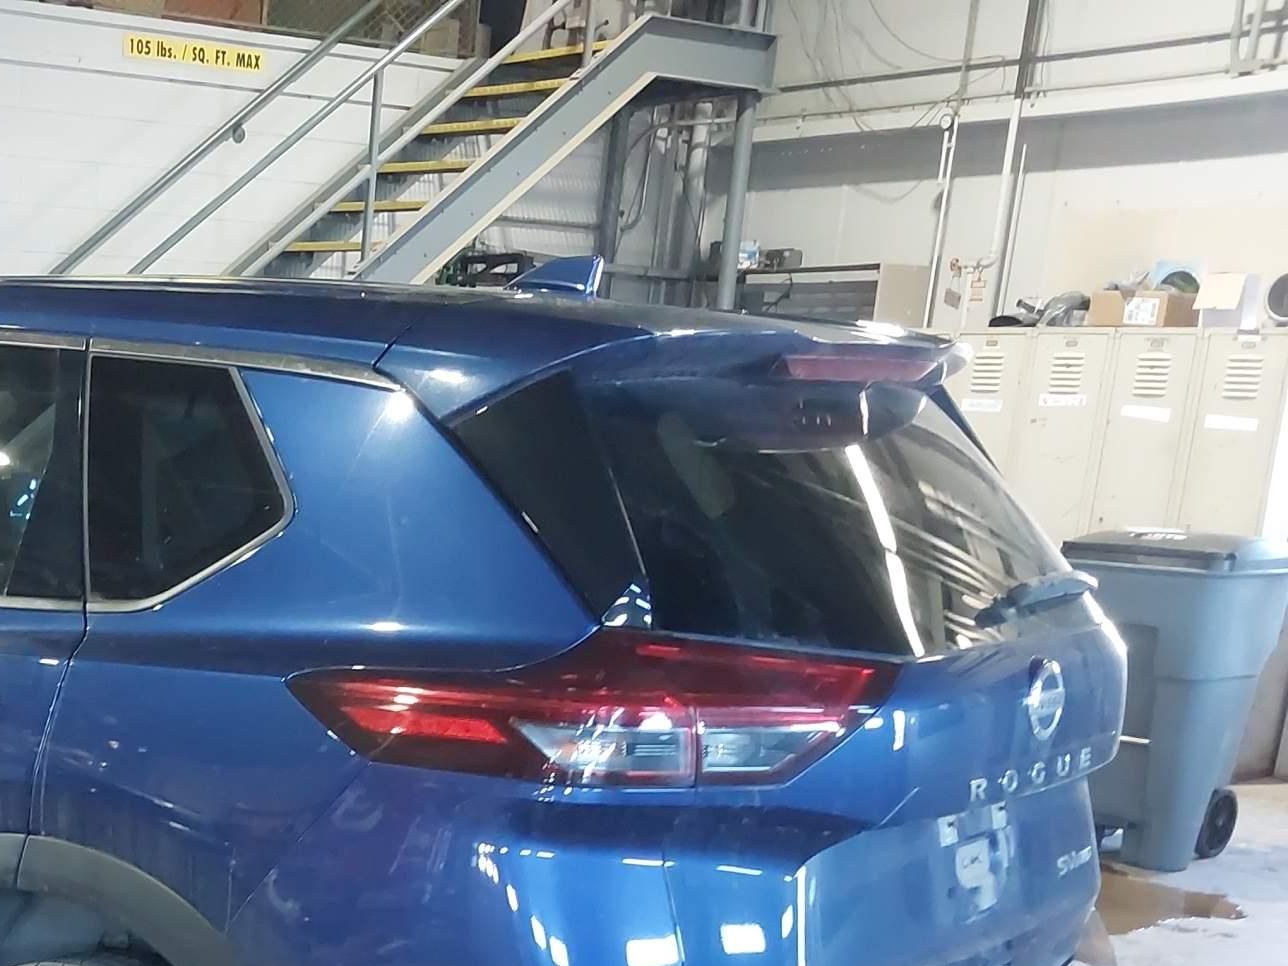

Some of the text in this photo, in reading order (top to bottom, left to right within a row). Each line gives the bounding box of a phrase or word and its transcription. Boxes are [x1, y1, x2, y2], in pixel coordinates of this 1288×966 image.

[129, 38, 151, 56] 105
[156, 40, 177, 59] lbs.
[192, 46, 209, 64] SQ.
[215, 50, 230, 66] FT.
[236, 52, 261, 70] MAX
[969, 747, 1092, 801] ROGUE
